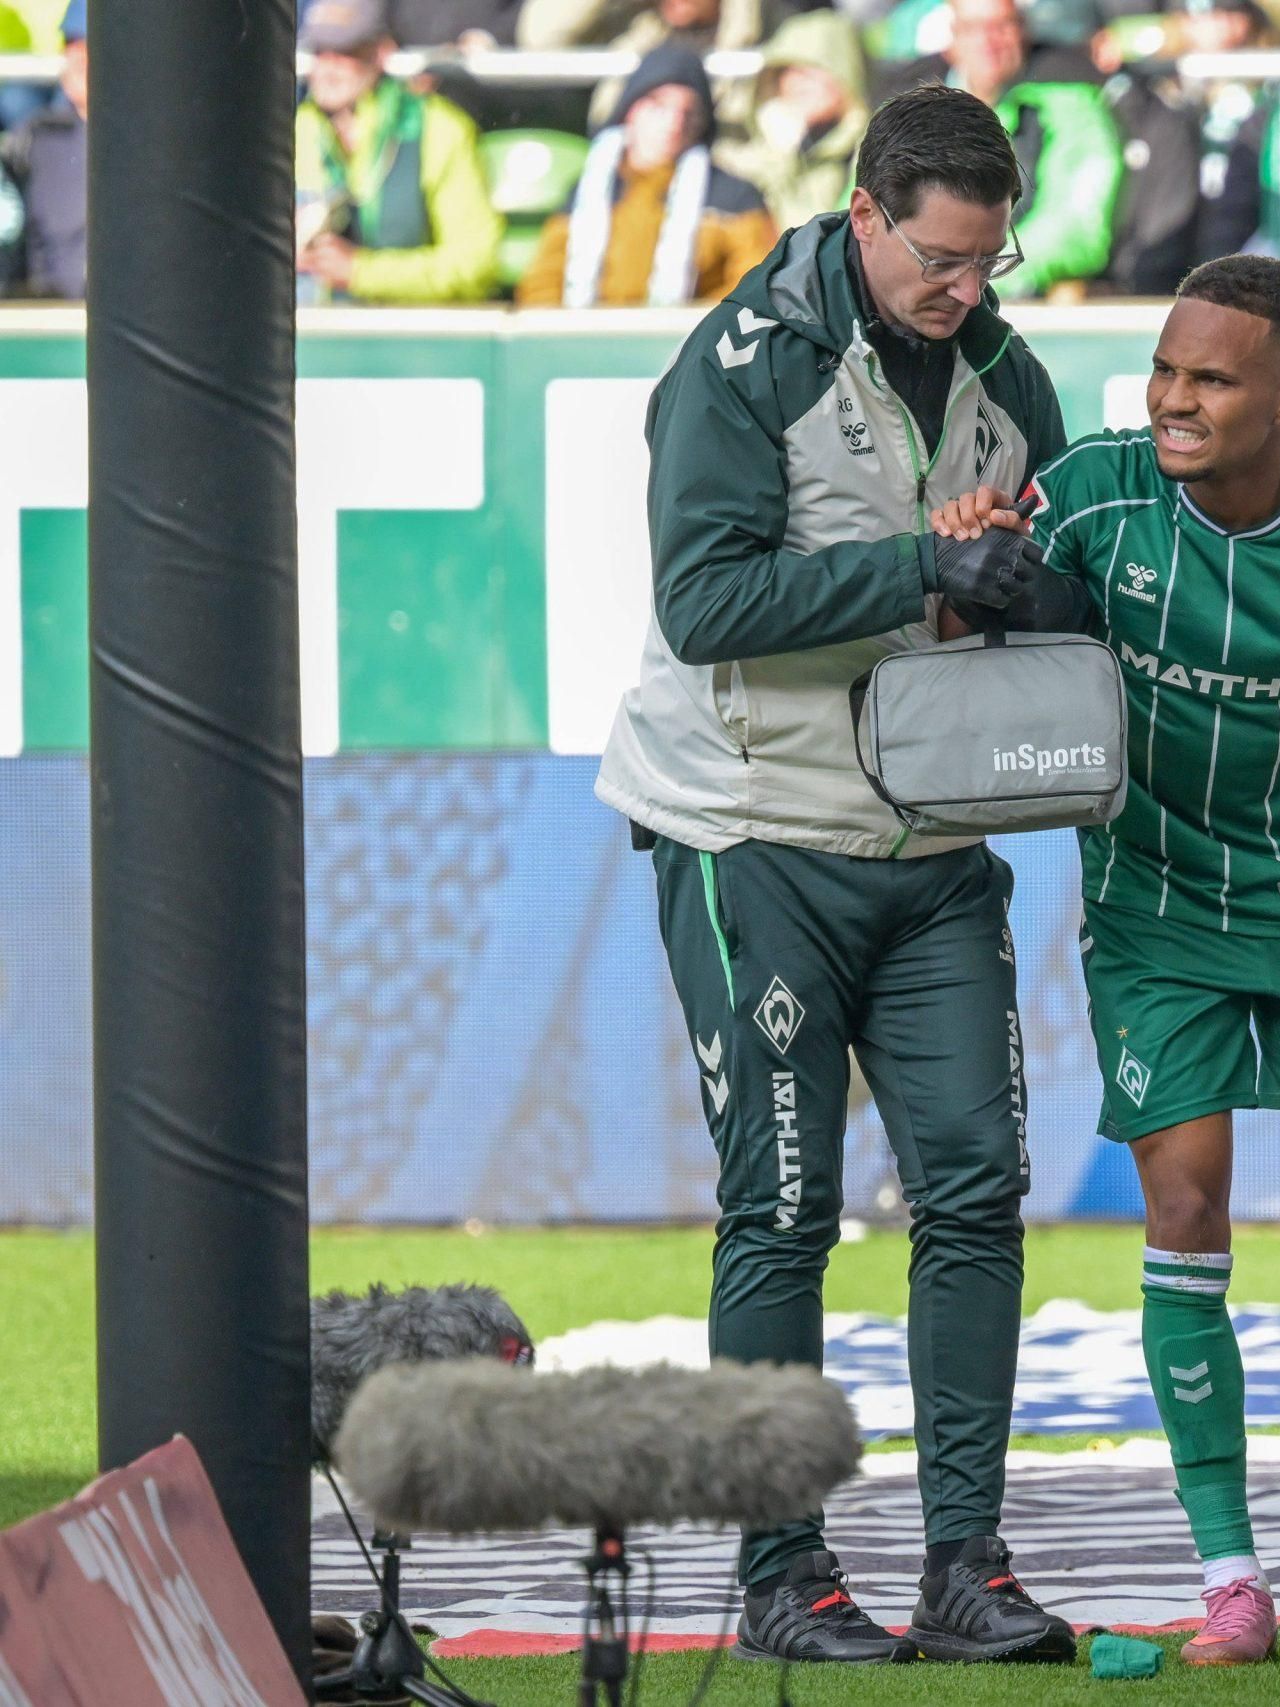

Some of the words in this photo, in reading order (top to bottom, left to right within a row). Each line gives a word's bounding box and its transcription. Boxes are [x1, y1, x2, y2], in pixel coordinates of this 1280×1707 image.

[1118, 583, 1157, 603] hummel
[993, 743, 1106, 776] inSports
[772, 1072, 803, 1234] MATTHÄI
